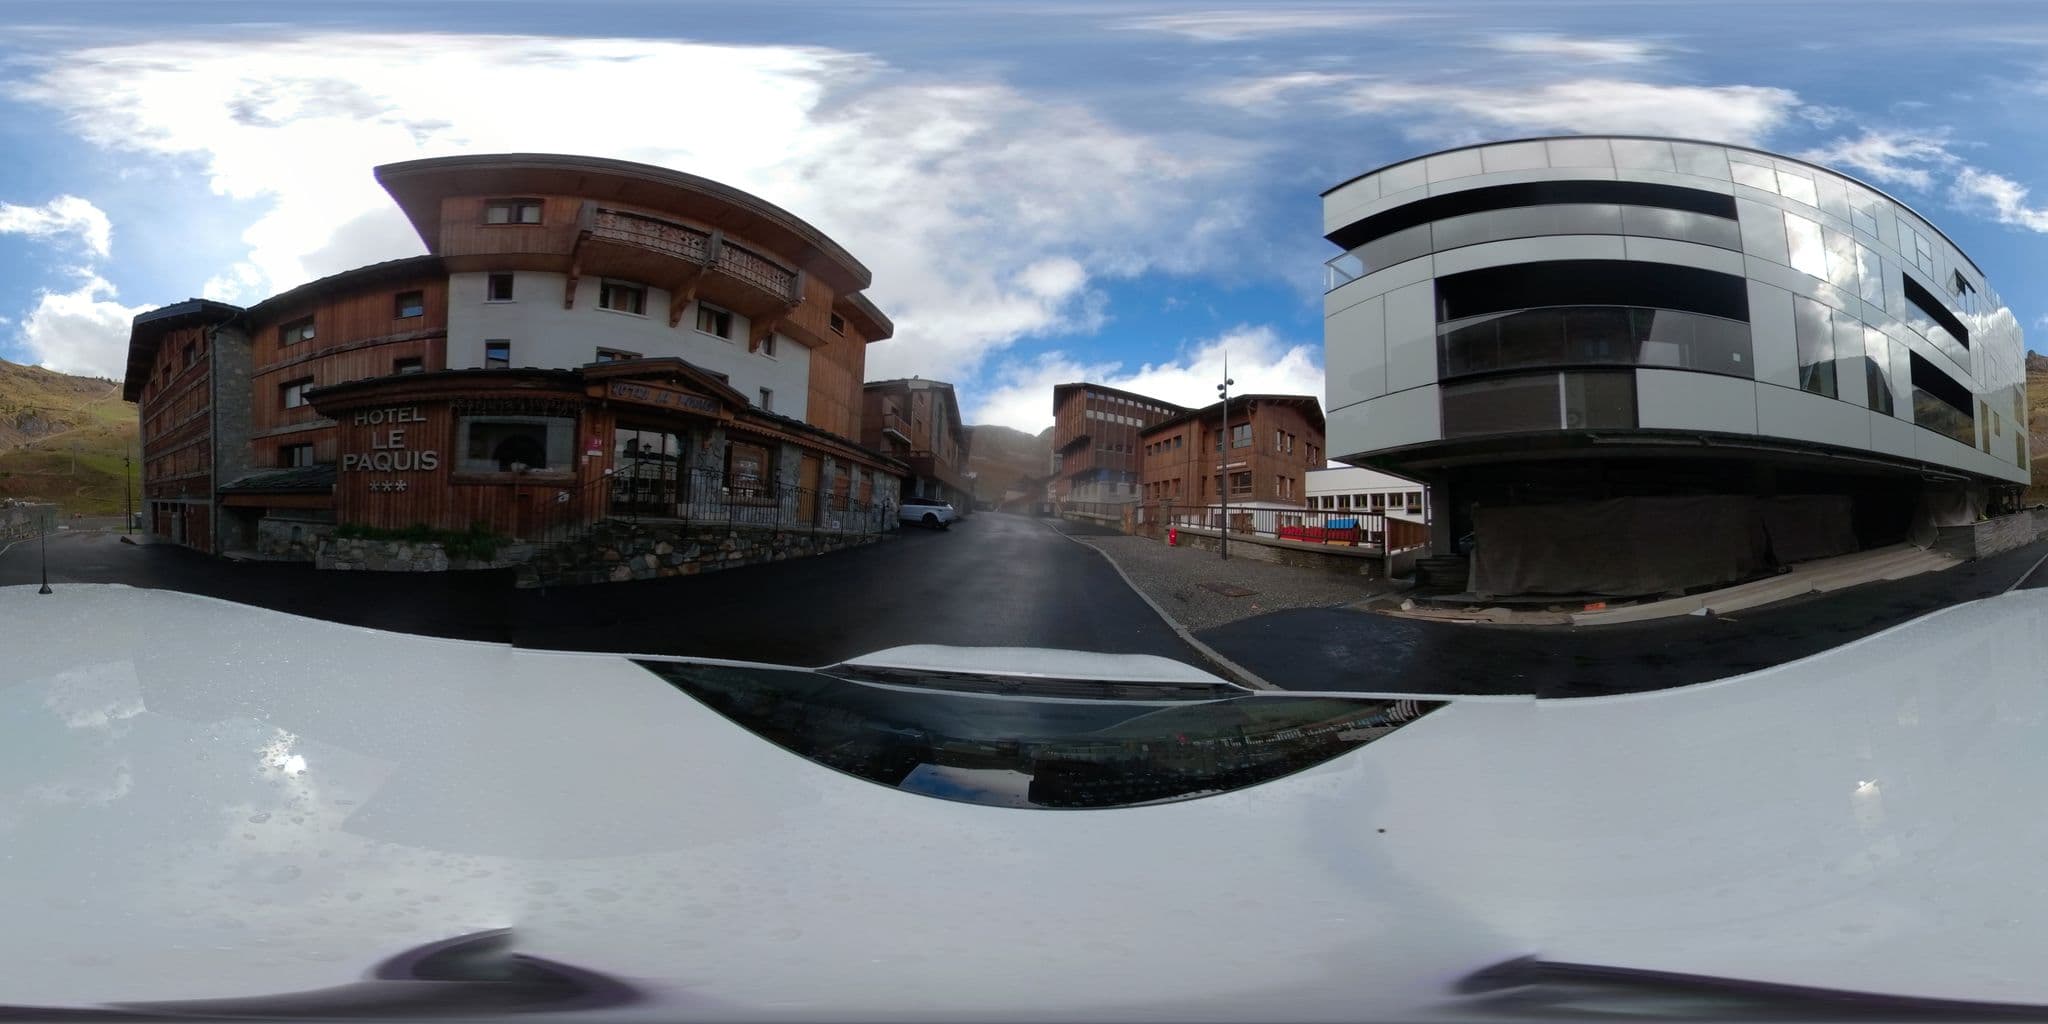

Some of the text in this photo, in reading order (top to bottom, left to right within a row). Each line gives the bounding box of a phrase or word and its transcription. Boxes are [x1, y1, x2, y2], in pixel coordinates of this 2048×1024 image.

[354, 407, 427, 426] HOTEL
[372, 429, 405, 449] LE
[343, 450, 439, 472] PAQUIS
